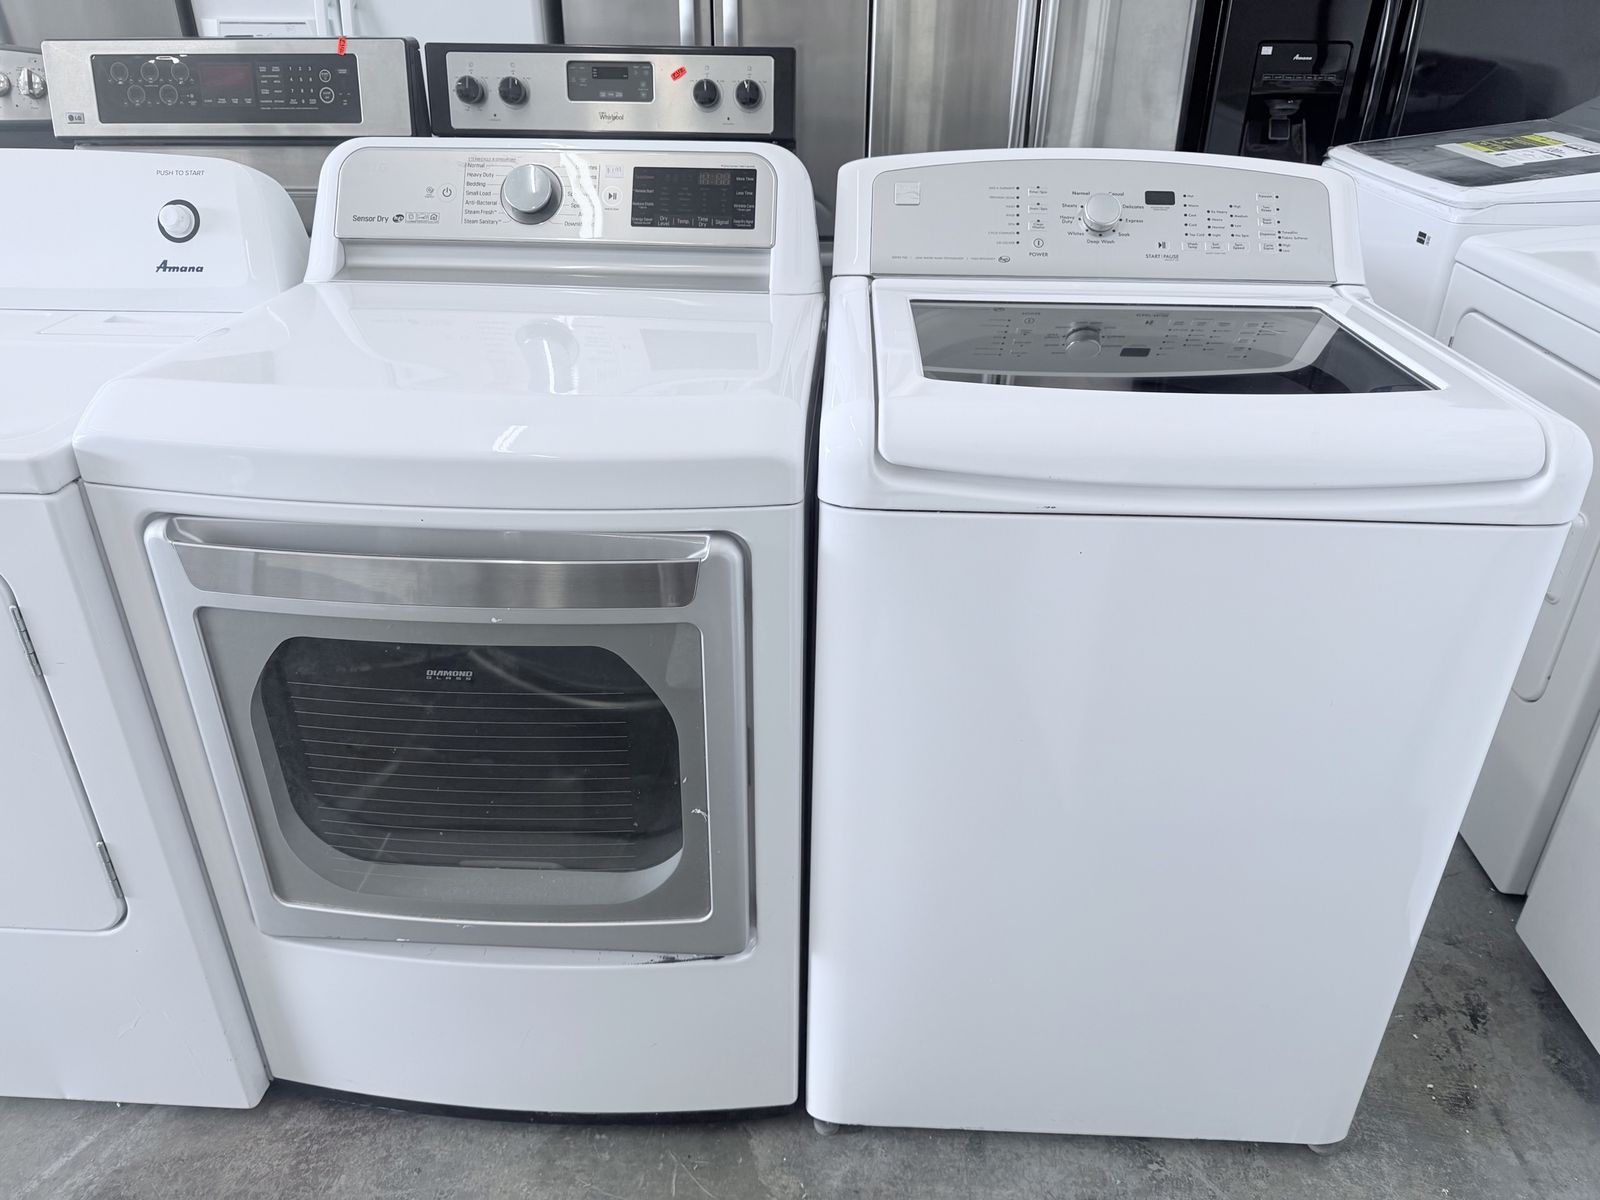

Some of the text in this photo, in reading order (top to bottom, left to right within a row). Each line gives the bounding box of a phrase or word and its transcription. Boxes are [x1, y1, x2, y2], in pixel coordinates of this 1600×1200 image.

[599, 112, 624, 123] Whirlpool
[352, 214, 390, 223] Sensor Dry
[155, 259, 204, 272] Amana
[426, 669, 473, 677] DIAMOND
